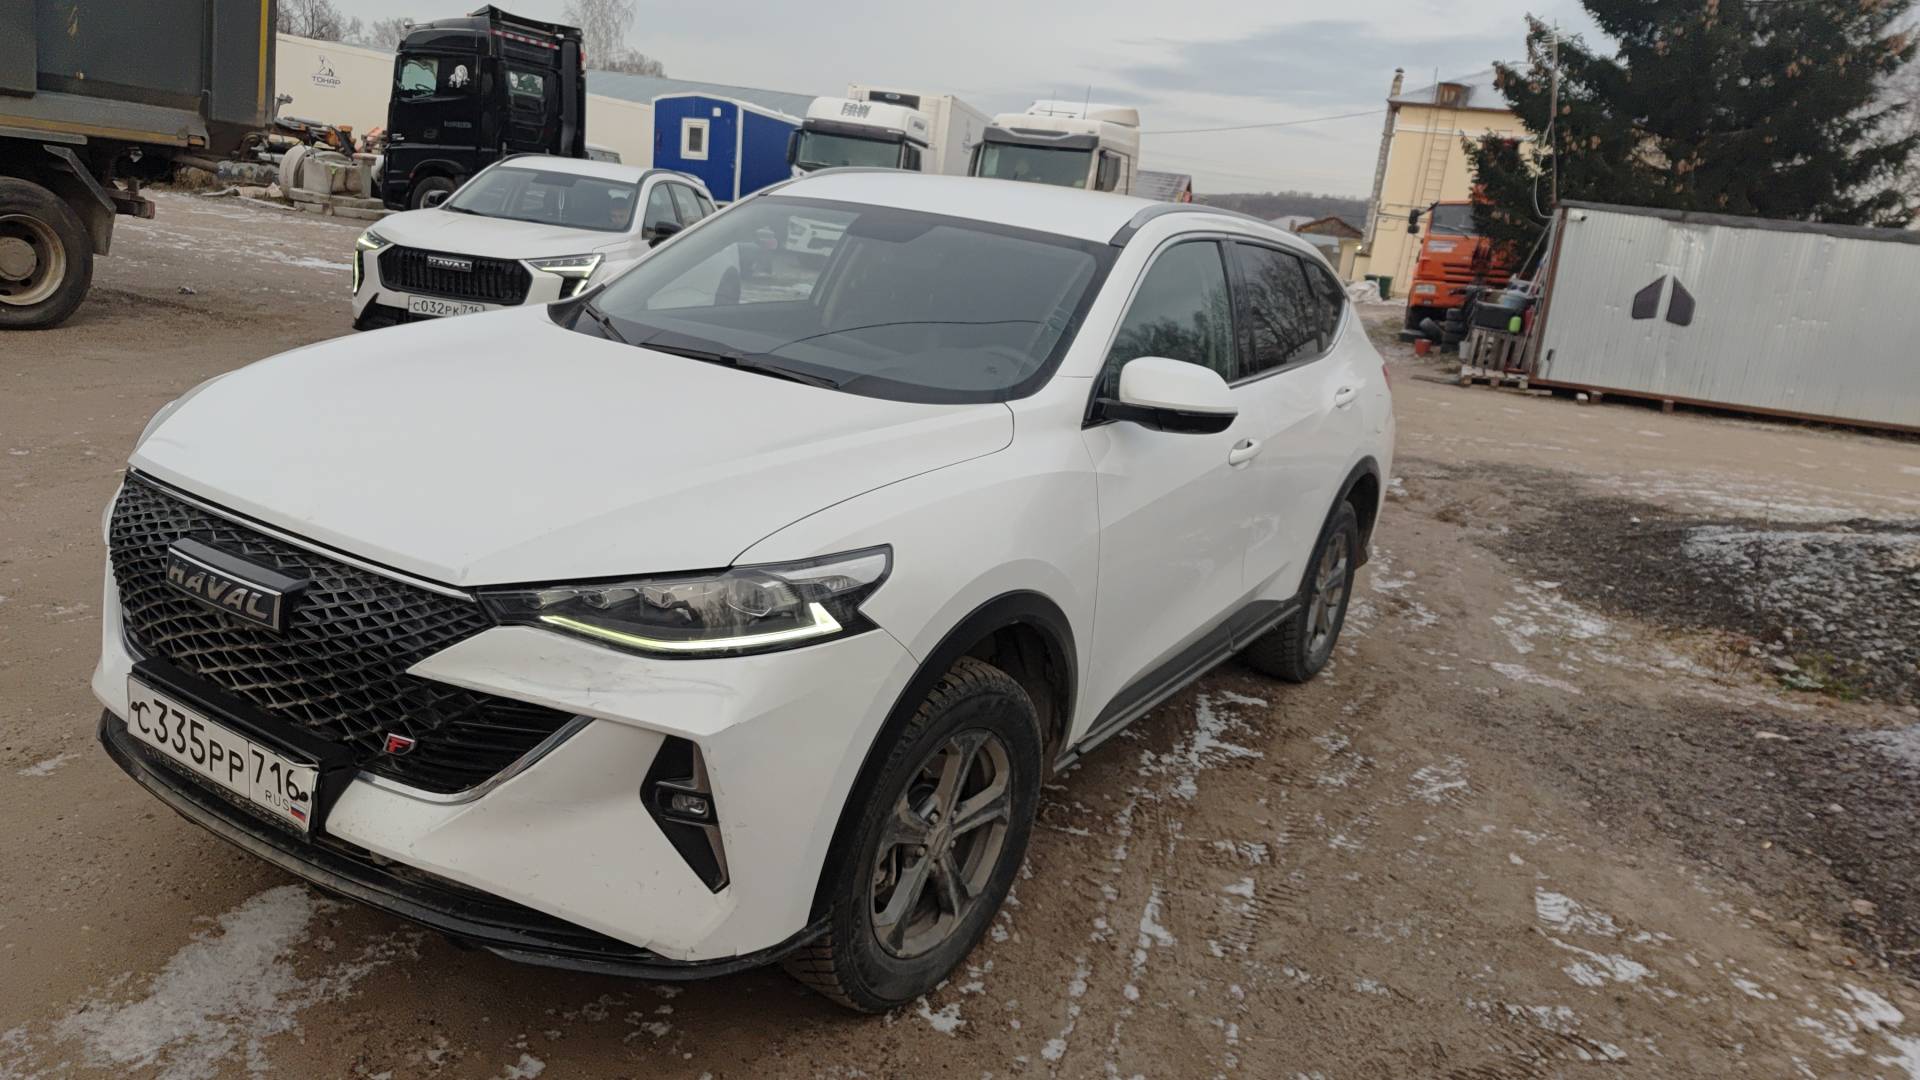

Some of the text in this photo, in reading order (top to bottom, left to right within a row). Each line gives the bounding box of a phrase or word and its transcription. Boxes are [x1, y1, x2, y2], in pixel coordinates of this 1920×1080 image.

[428, 259, 468, 269] HAVAL
[168, 560, 268, 619] HAVAL
[252, 749, 300, 801] 716
[265, 790, 290, 811] RUS
